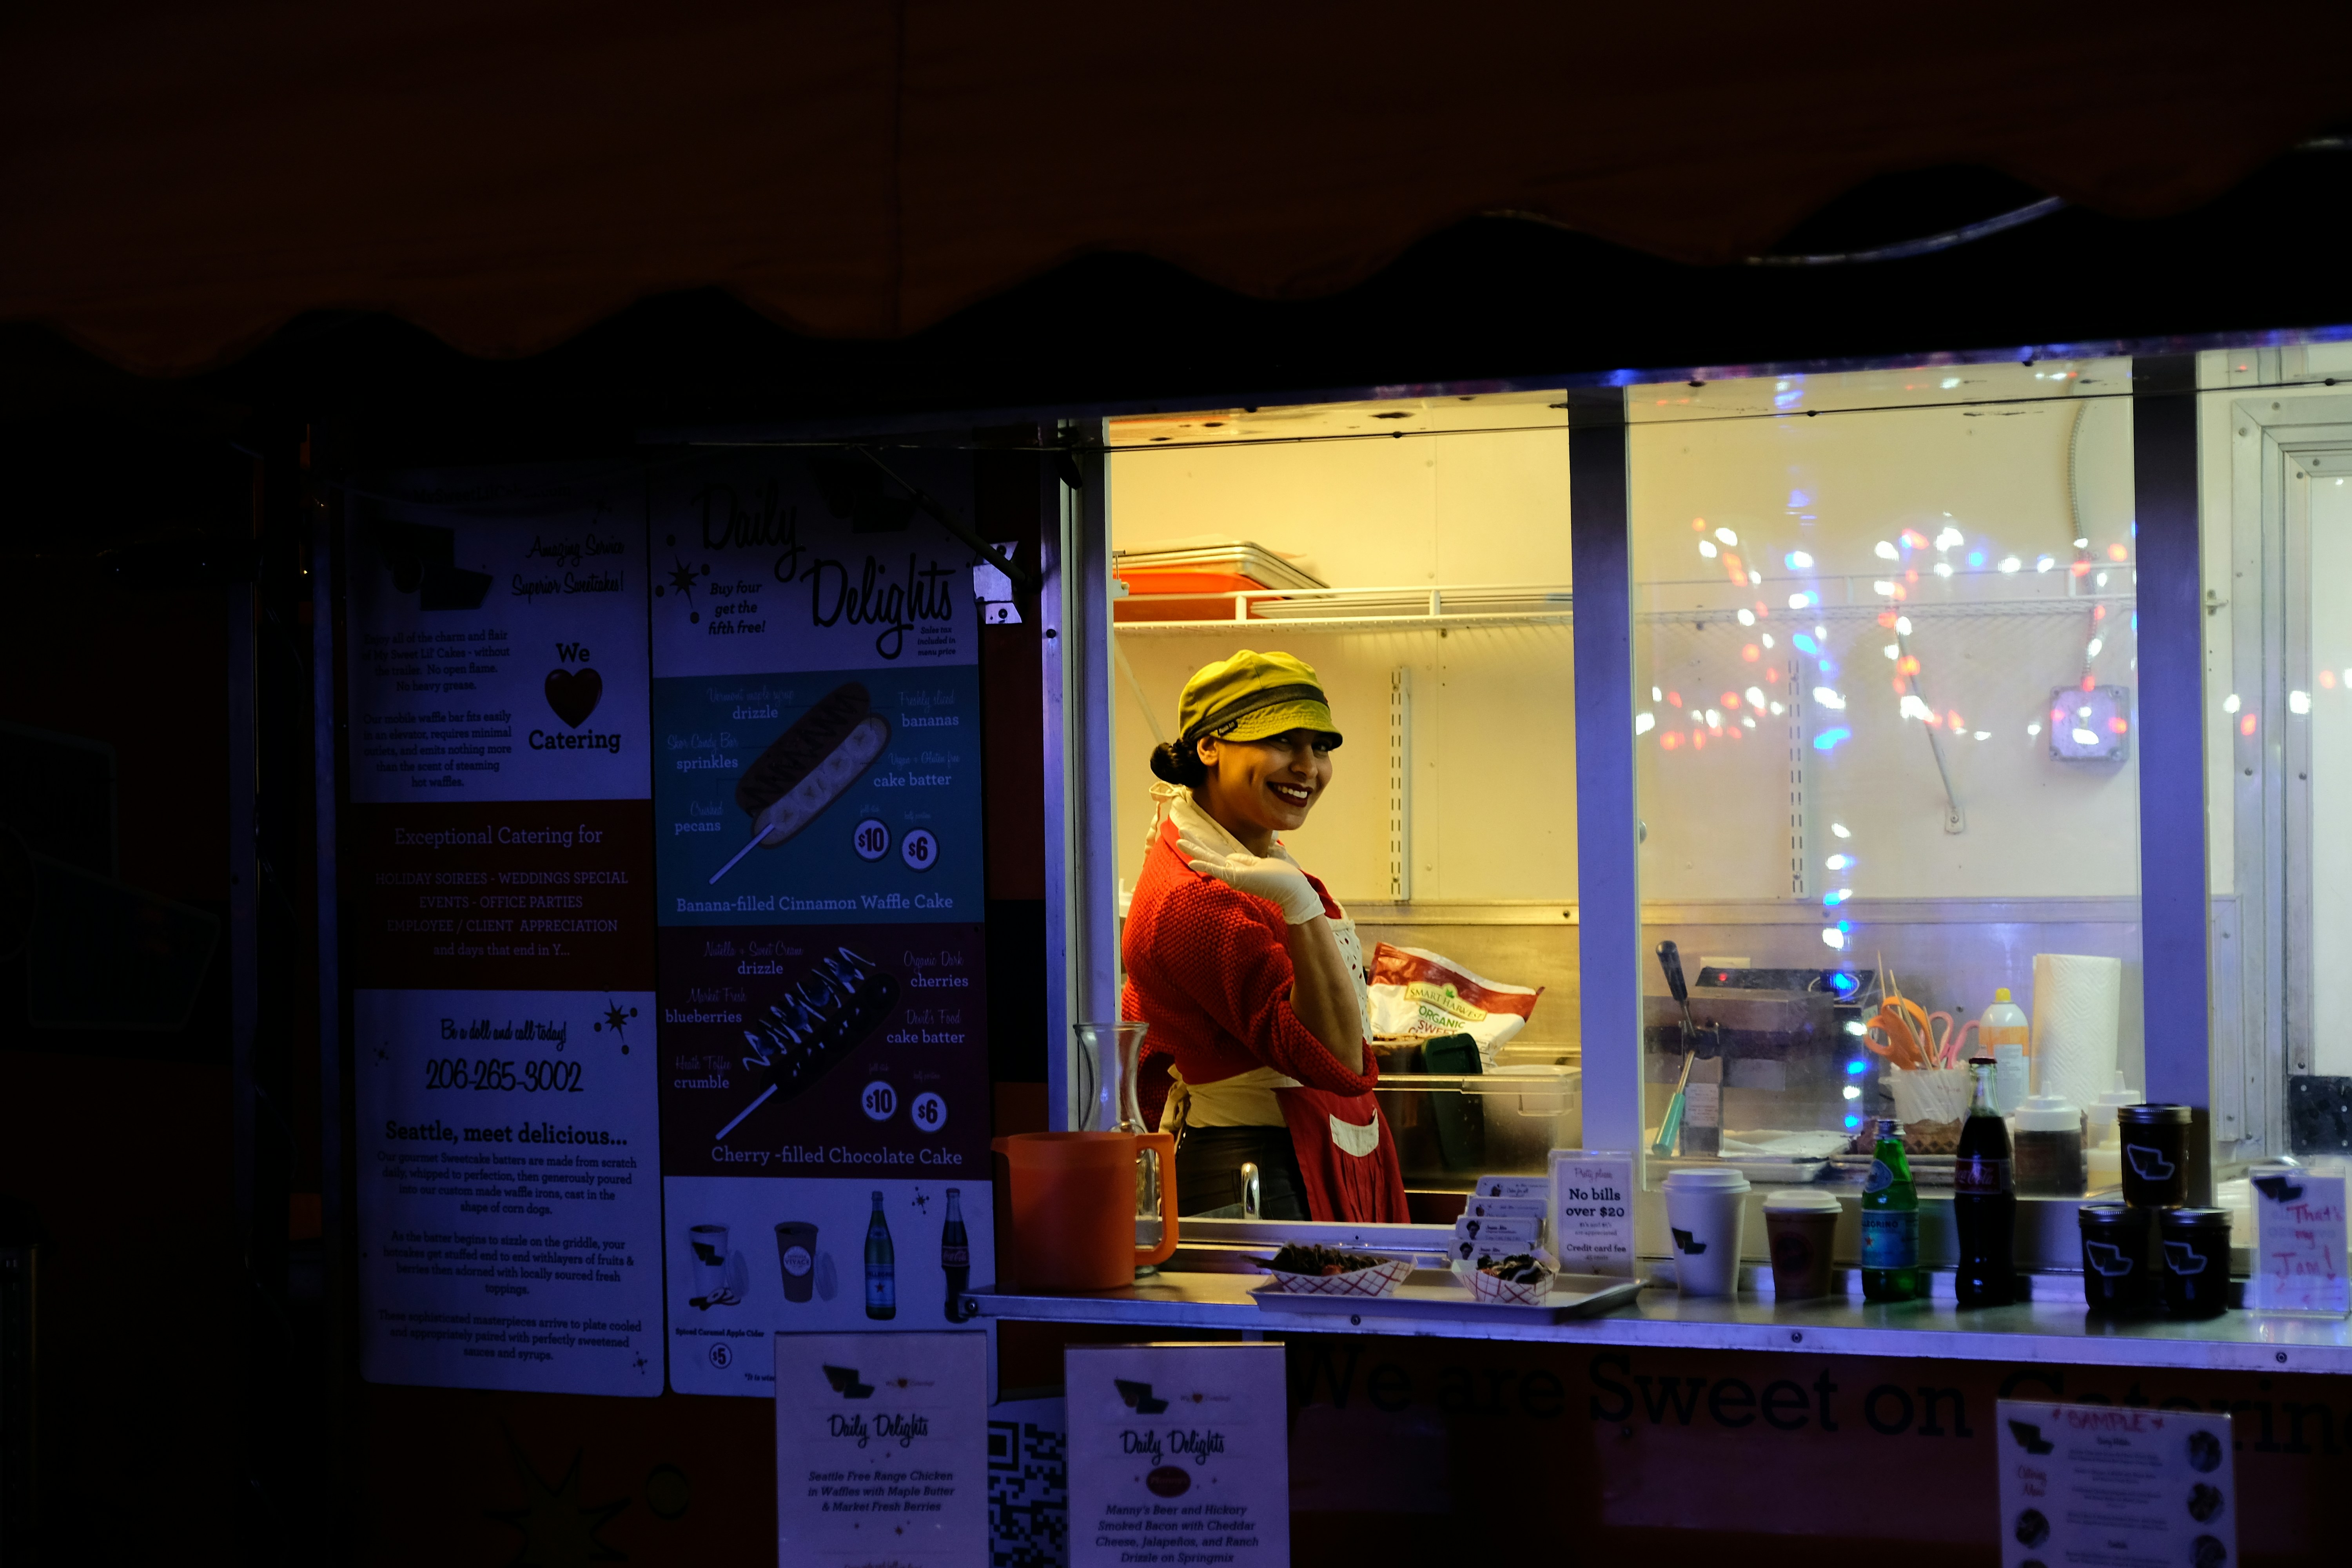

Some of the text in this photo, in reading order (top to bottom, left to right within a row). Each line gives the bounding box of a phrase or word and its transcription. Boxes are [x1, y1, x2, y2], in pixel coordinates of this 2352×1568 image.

[690, 477, 806, 583] Daily
[526, 534, 624, 567] Amazing Service
[512, 570, 624, 603] Superior Sweetcakes!
[710, 580, 762, 597] Buy four
[715, 600, 757, 617] get the
[800, 553, 956, 660] Delights
[709, 620, 766, 635] fifth free!
[920, 626, 939, 634] Sales
[917, 635, 947, 644] included
[556, 642, 590, 662] We
[938, 648, 956, 657] price
[733, 704, 778, 719] drizzle
[902, 713, 959, 727] bananas
[529, 730, 621, 754] Catering
[677, 753, 738, 772] sprinkles
[874, 772, 951, 787] cake batter
[396, 823, 603, 849] Exceptional Catering for
[675, 822, 721, 835] pecans
[858, 828, 884, 852] $10
[909, 837, 928, 861] $6
[375, 873, 432, 884] HOLIDAY
[435, 872, 487, 884] SOIREES
[498, 872, 570, 884] WEDDINGS
[573, 871, 629, 884] SPECIAL
[420, 896, 469, 907] EVENTS
[480, 896, 526, 908] OFFICE
[530, 895, 583, 908] PARTIES
[677, 892, 953, 911] Banana-filled Cinnamon Waffle Cake
[387, 919, 453, 931] EMPLOYEE
[466, 920, 514, 931] CLIENT
[520, 919, 618, 932] APPRECIATION
[434, 942, 454, 955] and
[457, 942, 484, 958] days
[487, 942, 510, 955] that
[513, 942, 535, 955] end
[538, 944, 550, 955] in
[738, 960, 783, 975] drizzle
[904, 950, 964, 974] Organic Dark
[911, 972, 968, 987] cherries
[686, 987, 747, 1003] Market Fresh
[1410, 988, 1483, 1019] SMART HARVEST
[665, 1009, 742, 1023] blueberries
[1419, 1005, 1465, 1029] ORGANIC
[887, 1029, 965, 1043] cake batter
[426, 1058, 583, 1092] 206-265-3002
[674, 1073, 730, 1089] crumble
[867, 1089, 892, 1113] $10
[918, 1099, 938, 1124] $6
[386, 1121, 458, 1144] Seattle,
[464, 1126, 512, 1142] meet
[711, 1145, 770, 1166] Cherry
[829, 1146, 914, 1164] Chocolate
[919, 1147, 962, 1164] Cake
[1569, 1188, 1621, 1201] No bills
[1600, 1207, 1624, 1218] $20
[2295, 1230, 2315, 1249] my
[675, 1327, 697, 1336] Spiced
[726, 1329, 745, 1338] Apple
[713, 1348, 726, 1365] $5
[1287, 1342, 1412, 1411] We
[1438, 1367, 1566, 1417] are
[1590, 1353, 1838, 1432] Sweet
[1865, 1384, 1973, 1437] on
[829, 1414, 928, 1448] Daily Delights
[1120, 1430, 1224, 1465] Daily Delights
[809, 1470, 953, 1483] Seattle Free Range Chicken
[808, 1486, 955, 1498] in Waffles with Maple Butter
[822, 1501, 941, 1511] & Market Fresh Berries
[1106, 1504, 1247, 1517] Manny's Beer and Hickory
[1098, 1521, 1254, 1530] Smoked Bacon with Cheddar
[1096, 1536, 1258, 1549] Cheese, Jalapeños, and Ranch
